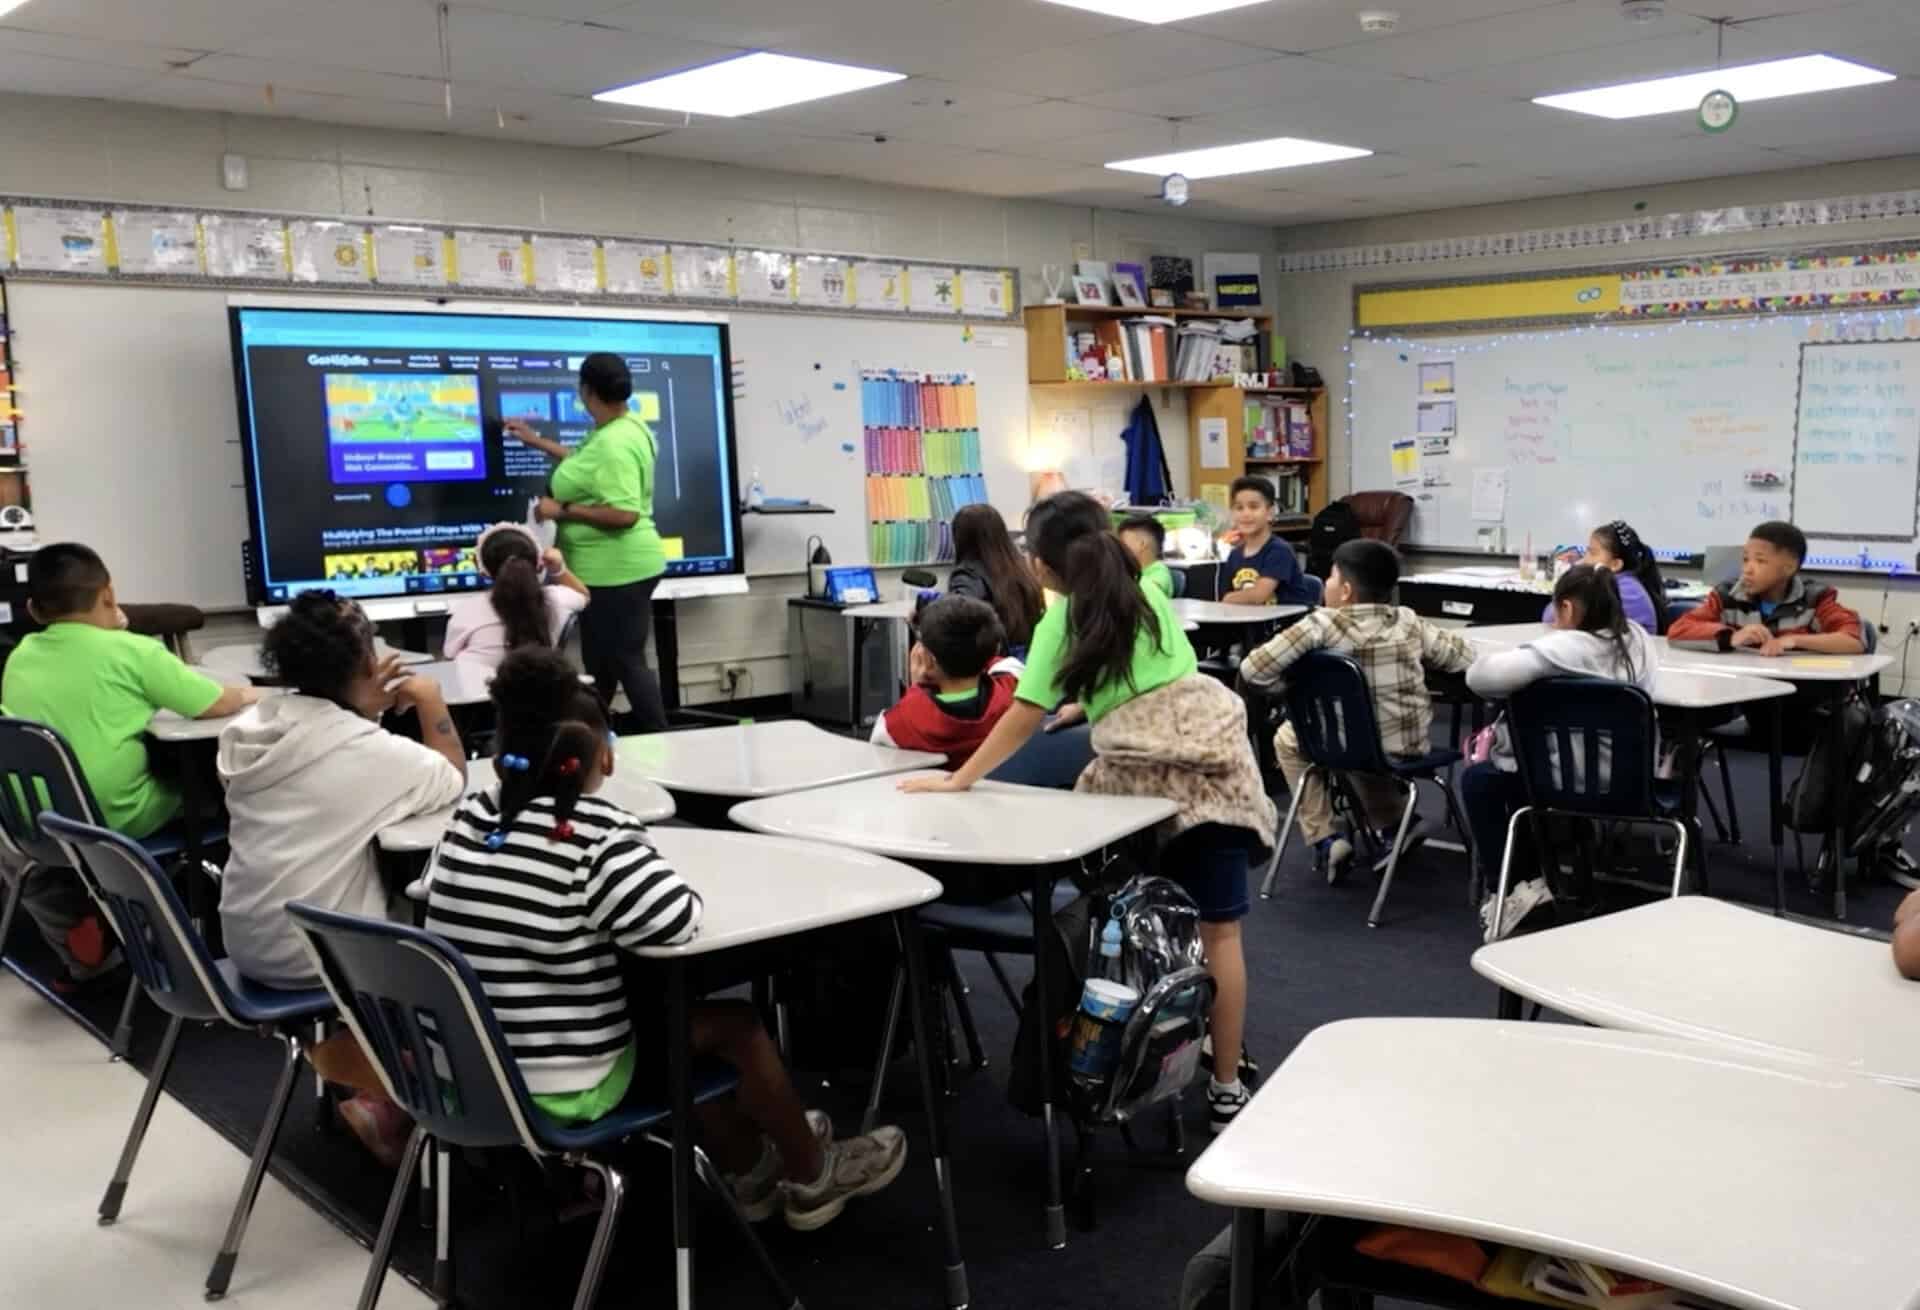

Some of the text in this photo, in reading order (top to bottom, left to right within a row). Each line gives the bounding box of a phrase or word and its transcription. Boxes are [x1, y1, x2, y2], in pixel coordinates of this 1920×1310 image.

[322, 529, 375, 542] Multiplying
[376, 527, 394, 538] The
[395, 526, 423, 537] Power
